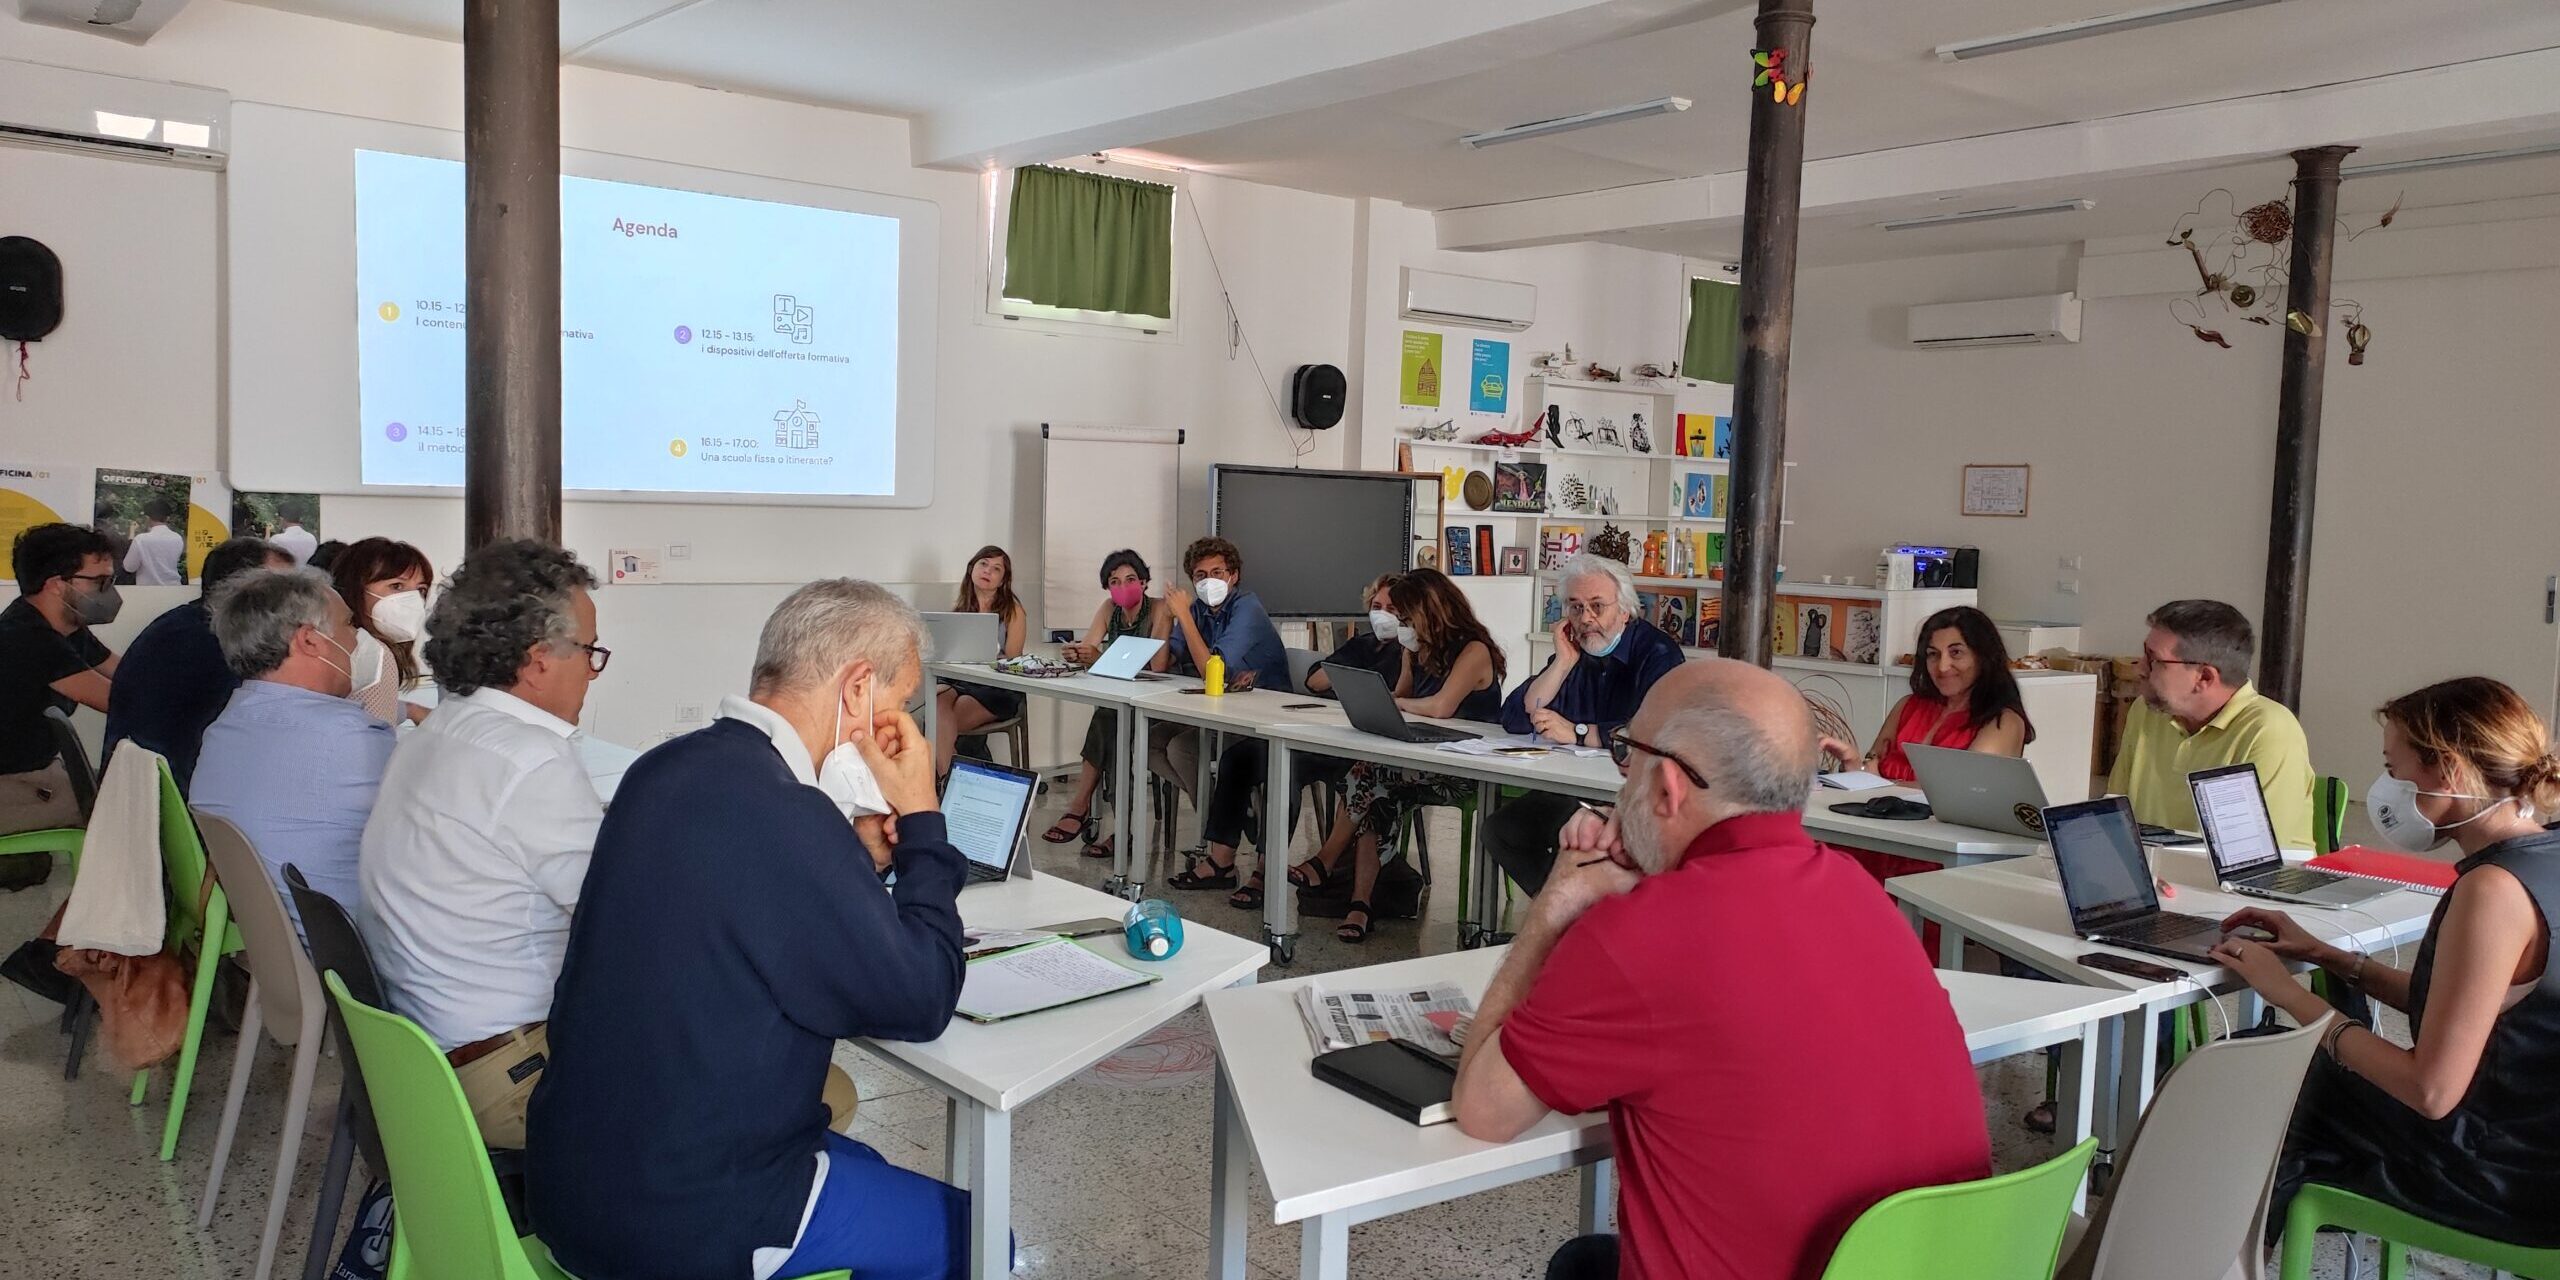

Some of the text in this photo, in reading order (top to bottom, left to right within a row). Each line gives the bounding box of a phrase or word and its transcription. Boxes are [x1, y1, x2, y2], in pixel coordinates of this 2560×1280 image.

[612, 217, 678, 239] Agenda
[706, 345, 755, 357] dispositivi
[807, 352, 850, 364] formativa
[701, 437, 722, 447] 16.15
[701, 452, 720, 462] Una
[722, 454, 752, 463] scuola
[754, 454, 775, 464] fissa
[785, 454, 834, 466] itinerante?
[102, 474, 148, 485] OFFICINA
